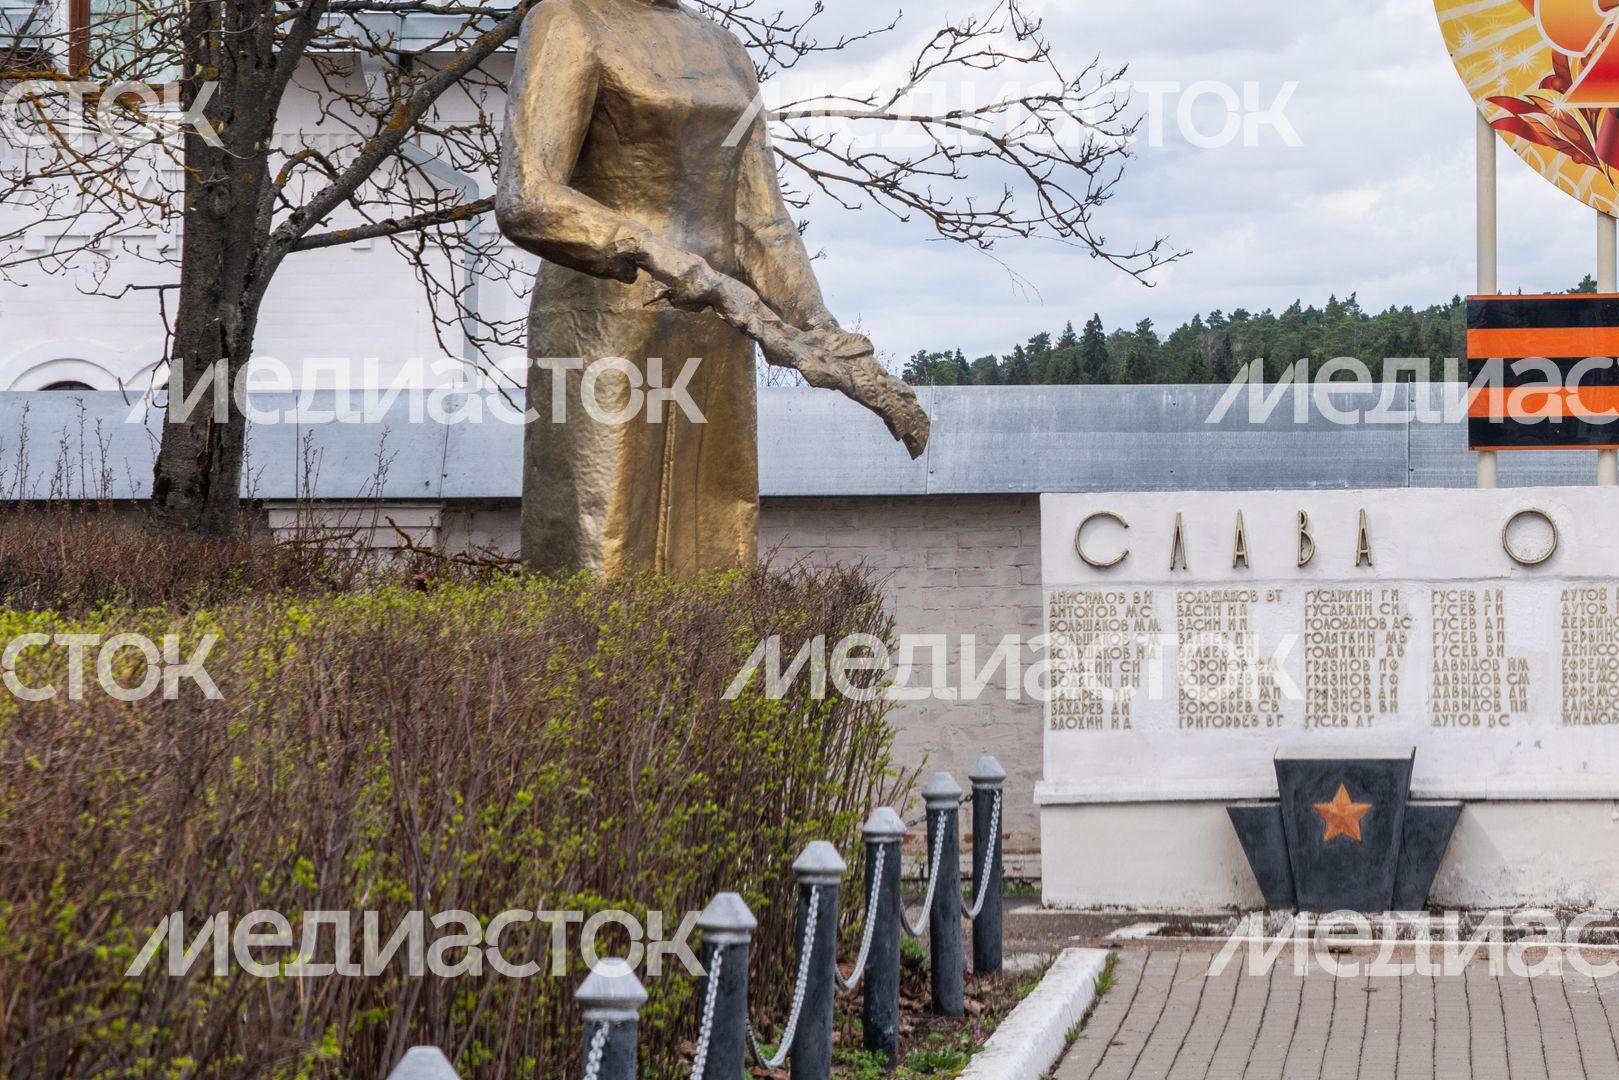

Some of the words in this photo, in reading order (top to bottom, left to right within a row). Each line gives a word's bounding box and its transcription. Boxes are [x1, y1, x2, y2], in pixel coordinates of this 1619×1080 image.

[1075, 508, 1372, 570] СЛАВА
[1502, 506, 1559, 565] О
[1305, 589, 1372, 603] ГУСАРКИН
[1432, 590, 1476, 603] ГУСЕВ
[1050, 605, 1117, 618] АНТОНОВ
[1305, 603, 1372, 616] ГУСАРКИН
[1432, 604, 1476, 617] ГУСЕВ
[1305, 617, 1386, 630] ГОЛОВАНОВ
[1433, 617, 1477, 631] ГУСЕВ
[1305, 631, 1375, 644] ГОЛЯТКИН
[1433, 631, 1477, 644] ГУСЕВ
[1305, 645, 1375, 658] ГОЛЯТКИН
[1433, 645, 1478, 658] ГУСЕВ
[1433, 659, 1500, 672] ДАВЫДОВ
[1433, 673, 1501, 686] ДАВЫДОВ
[1433, 686, 1501, 699] ДАВЫДОВ
[1433, 700, 1502, 712] ДАВЫДОВ
